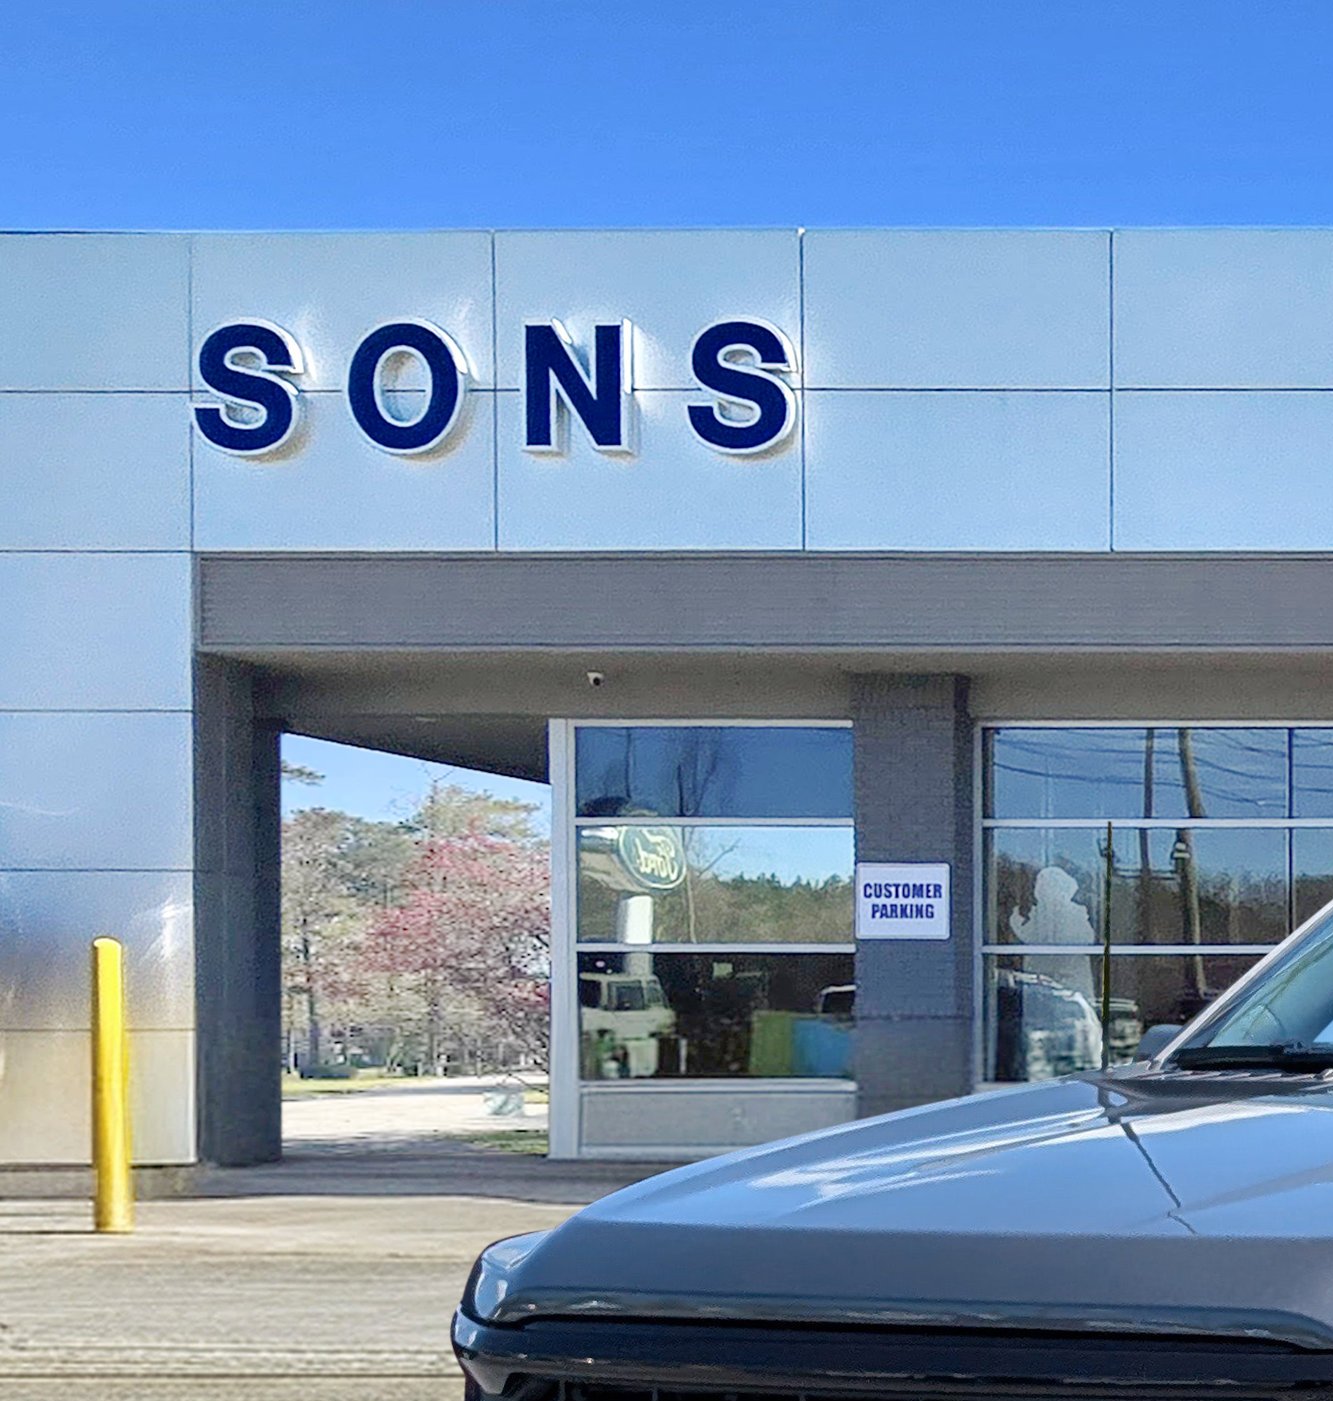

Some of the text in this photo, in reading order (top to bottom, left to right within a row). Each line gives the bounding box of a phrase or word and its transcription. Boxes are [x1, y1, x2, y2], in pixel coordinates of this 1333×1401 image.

[193, 318, 798, 453] SONS
[863, 882, 943, 899] CUSTOMER
[871, 903, 935, 919] PARKING
